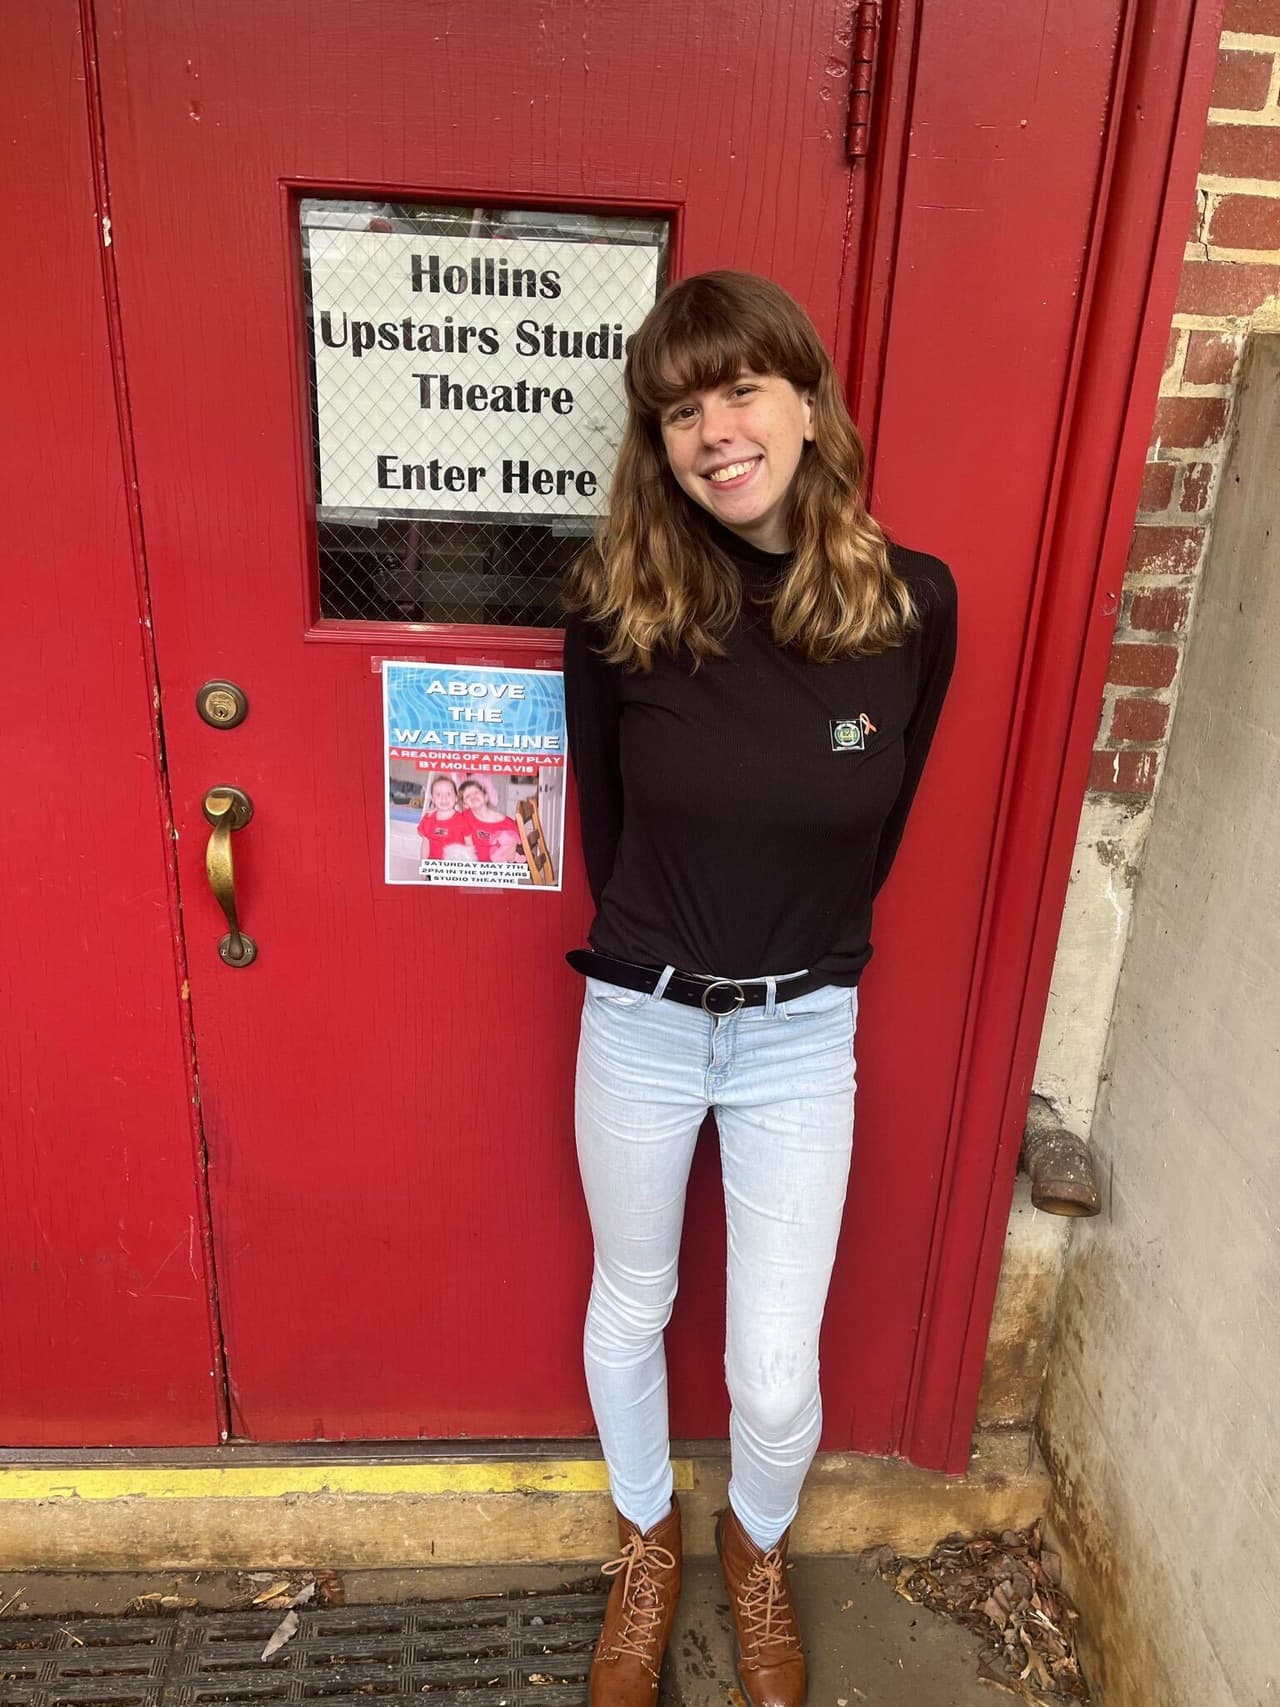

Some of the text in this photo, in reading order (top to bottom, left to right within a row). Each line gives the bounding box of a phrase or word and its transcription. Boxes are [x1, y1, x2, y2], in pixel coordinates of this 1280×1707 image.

[411, 254, 562, 299] Hollins
[320, 310, 500, 357] Upstairs
[411, 373, 574, 415] Theatre
[377, 455, 597, 496] Enter Here
[426, 680, 525, 700] ABOVE
[448, 706, 503, 723] THE
[394, 728, 561, 749] WATERLINE
[401, 751, 461, 761] READING
[462, 753, 480, 761] OF
[481, 754, 492, 762] A
[493, 755, 525, 763] NEW
[526, 756, 561, 764] PLAY
[419, 761, 534, 773] BY MOLLIE DAVIS
[424, 860, 478, 869] SATURDAY
